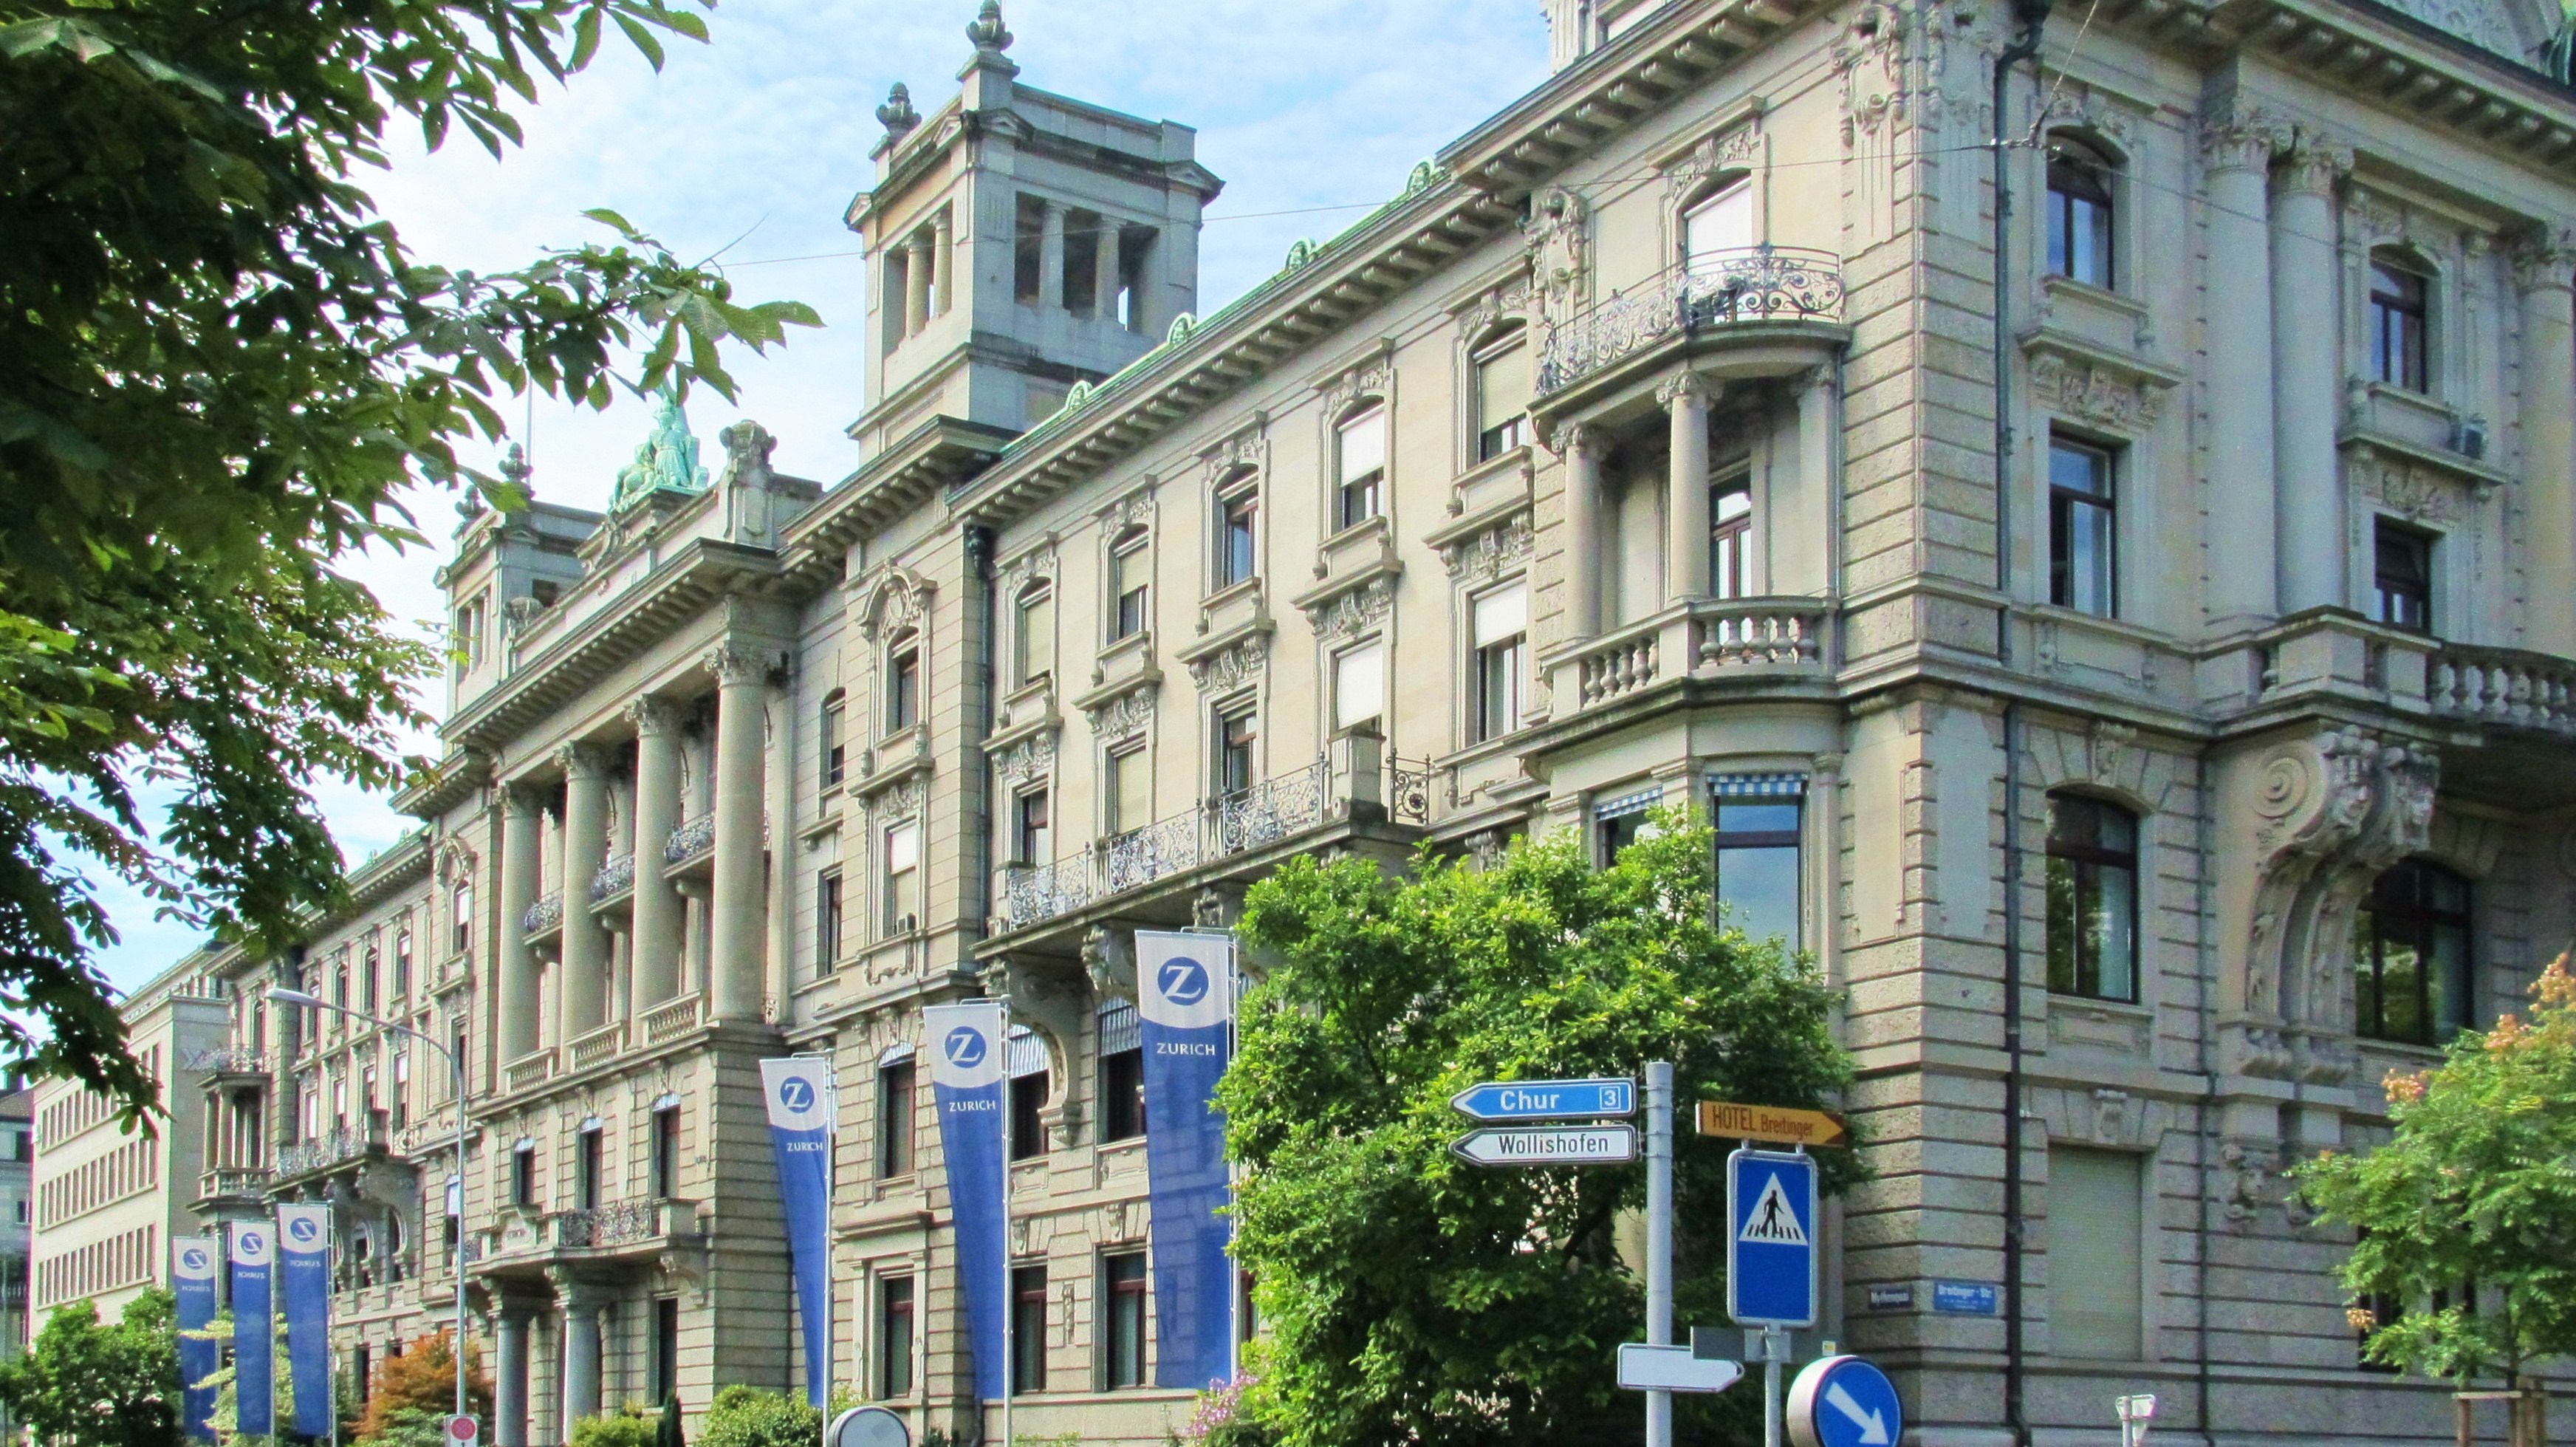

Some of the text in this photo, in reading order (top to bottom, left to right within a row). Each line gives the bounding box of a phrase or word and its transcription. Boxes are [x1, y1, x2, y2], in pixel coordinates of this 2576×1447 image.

[1164, 965, 1202, 998] Z
[950, 1034, 981, 1062] Z
[1156, 1042, 1216, 1056] ZURICH
[784, 1082, 810, 1108] Z
[948, 1100, 996, 1112] ZURICH
[1500, 1089, 1617, 1111] Chur 3
[1712, 1105, 1815, 1140] HOTEL Breitinger
[787, 1142, 823, 1152] ZURICH
[1498, 1133, 1609, 1154] Wollishofen
